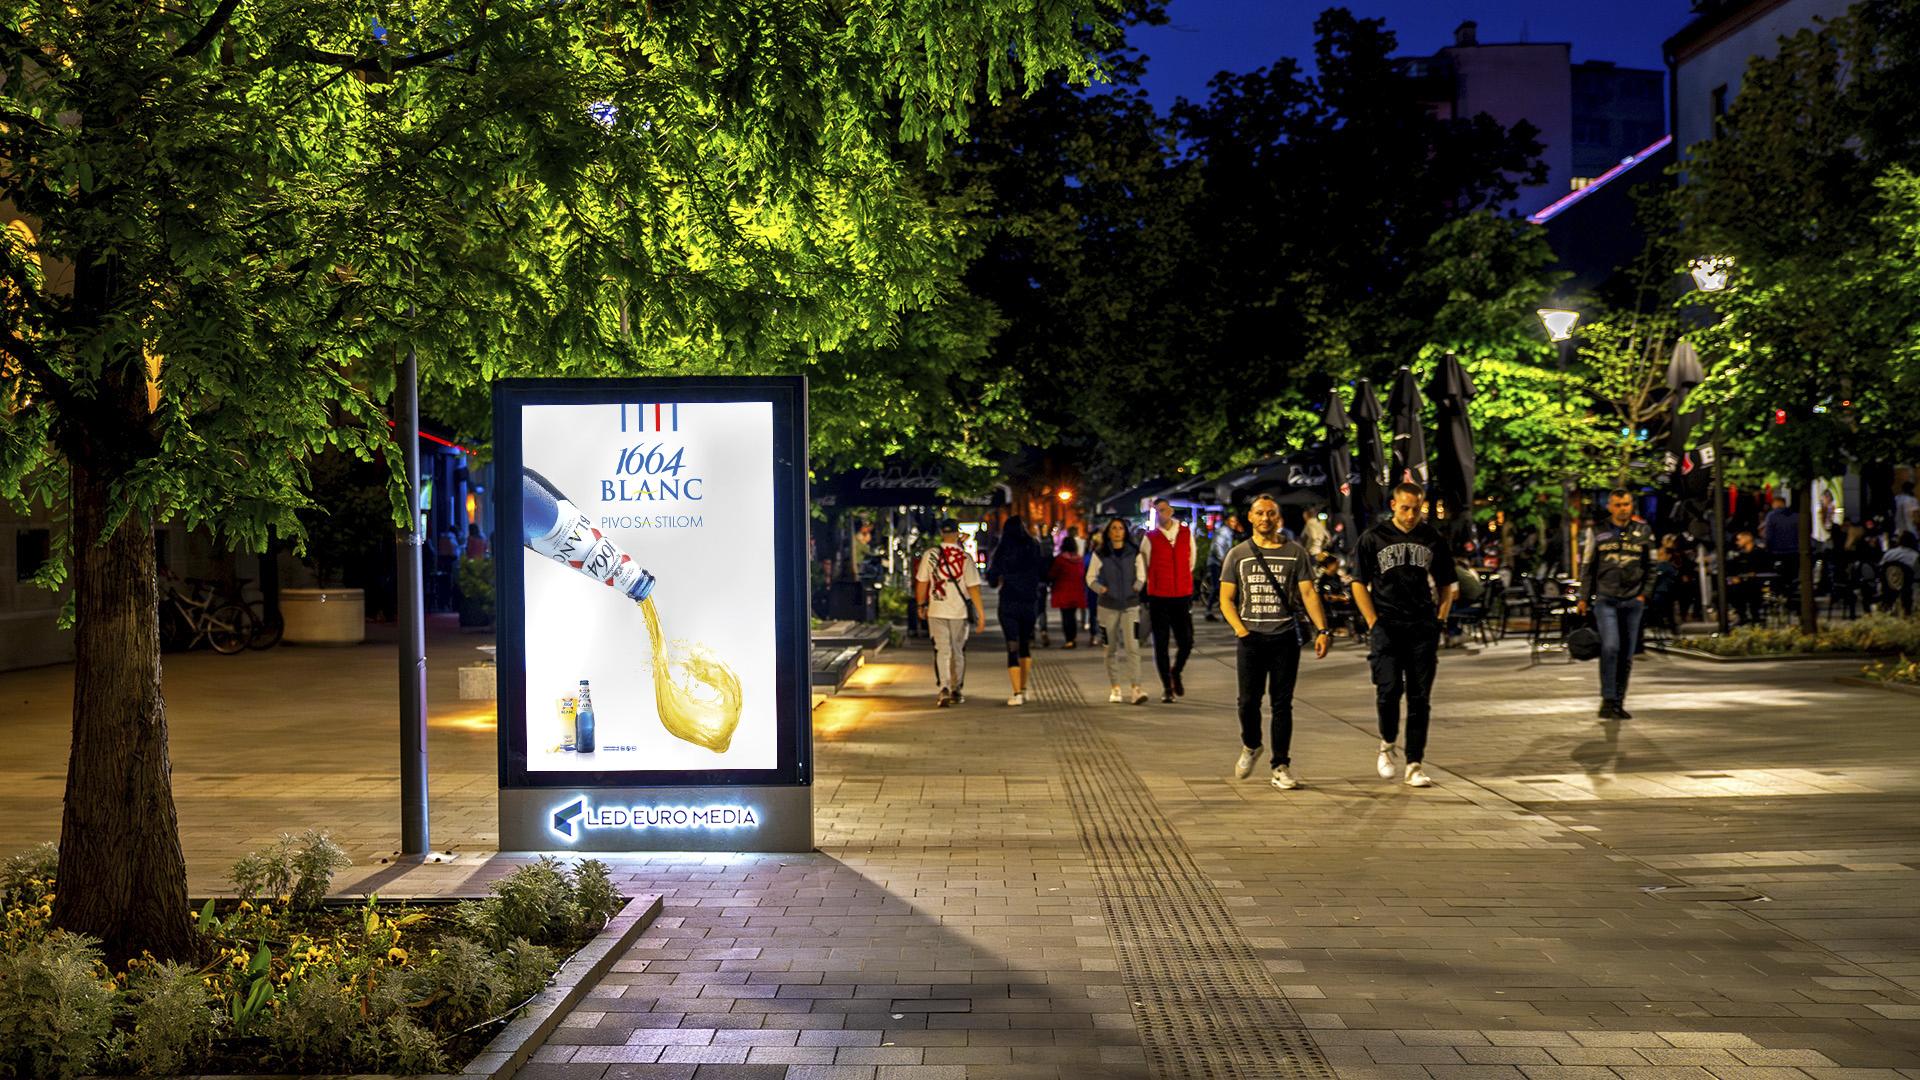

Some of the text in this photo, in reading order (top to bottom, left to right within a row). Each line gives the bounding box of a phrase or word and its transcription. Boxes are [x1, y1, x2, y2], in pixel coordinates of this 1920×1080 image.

[615, 442, 687, 477] 1664
[600, 478, 703, 502] BLANC
[601, 515, 703, 529] PIVO SA STILOM
[587, 539, 616, 578] 1664
[1376, 542, 1434, 574] NEW YO
[1257, 564, 1284, 573] RLLY
[1247, 574, 1266, 584] NEED
[1250, 584, 1284, 594] BETWE
[1250, 594, 1282, 604] SATURDA
[587, 808, 756, 826] LED EURO MEDIA
